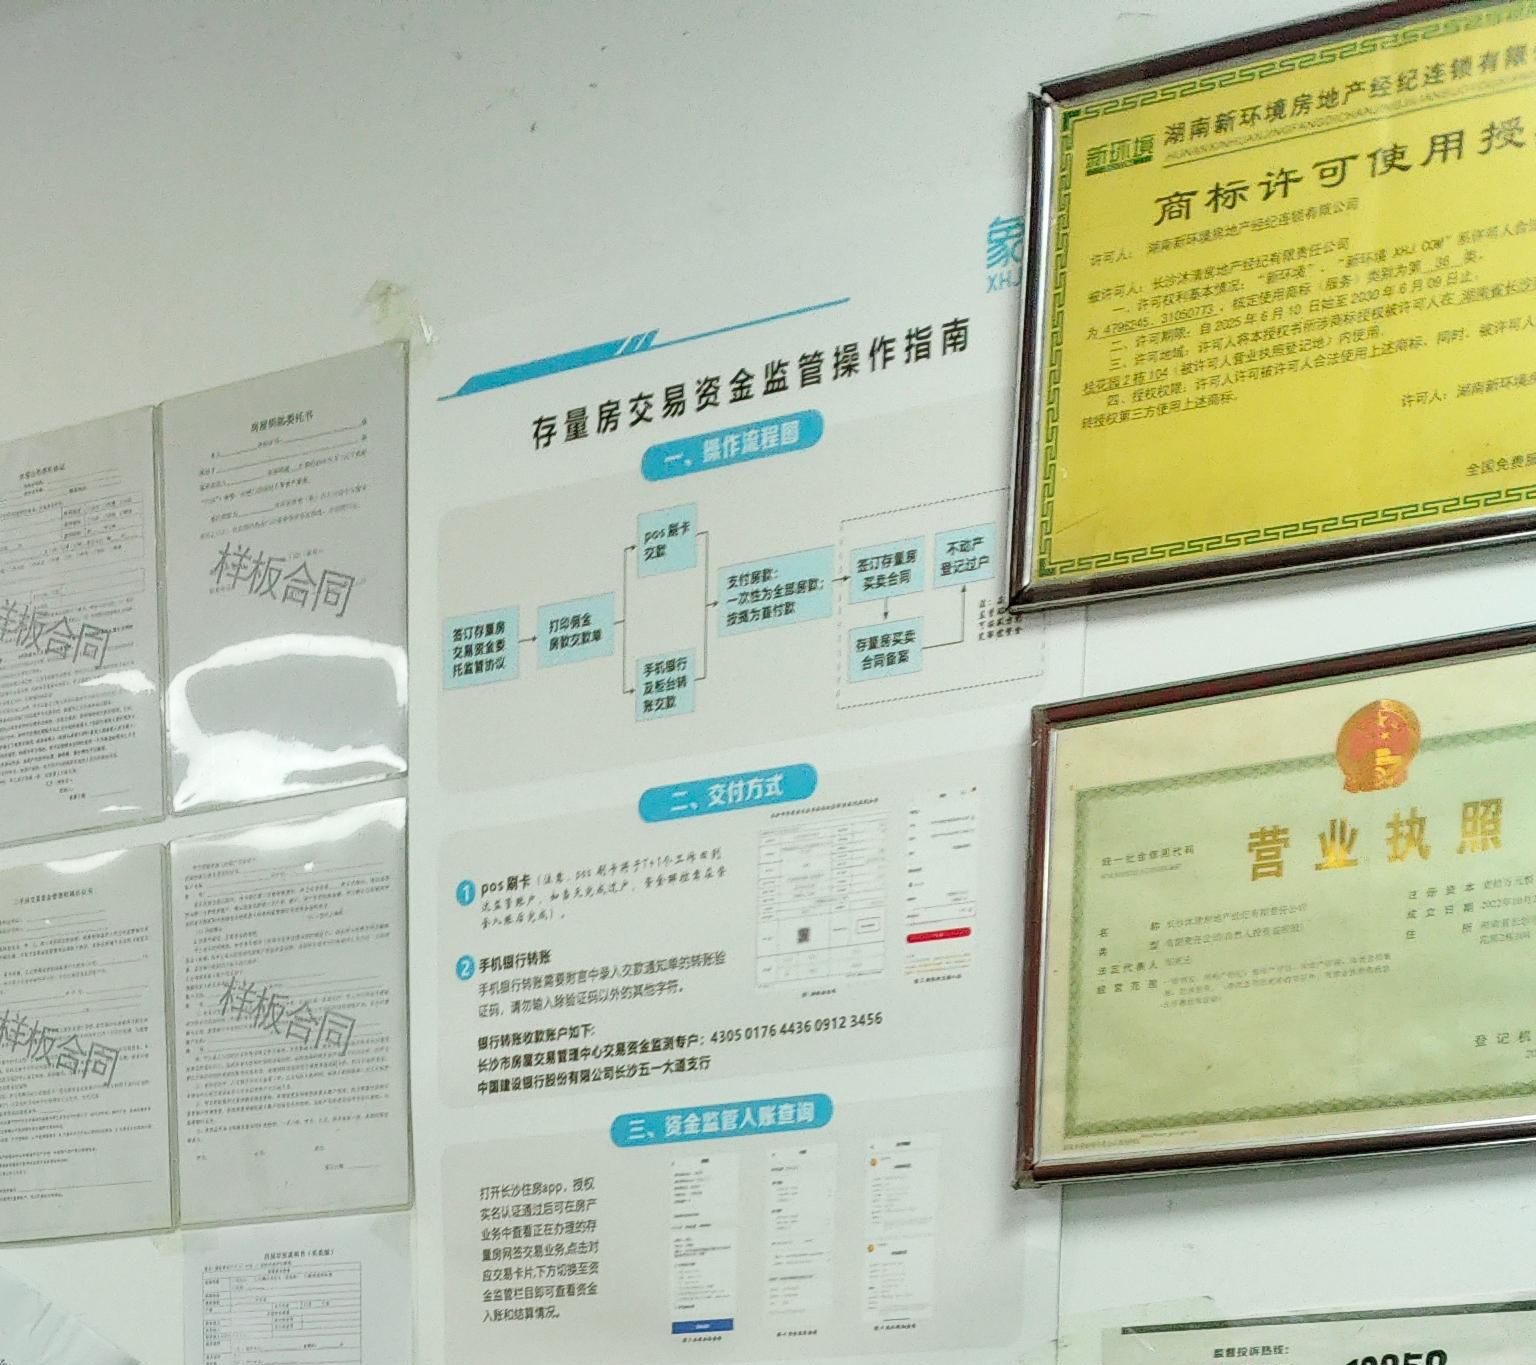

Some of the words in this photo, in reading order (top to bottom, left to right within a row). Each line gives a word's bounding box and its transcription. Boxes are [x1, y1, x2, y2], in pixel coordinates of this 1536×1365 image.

[1164, 44, 1536, 145] 湖南新环境房地产经纪连锁有限
[1086, 134, 1155, 167] 新环境
[1154, 115, 1526, 226] 商标许可使用授
[531, 316, 970, 450] 存量房交易资金监管操作指南
[663, 420, 801, 469] 一、操作流程图
[211, 541, 356, 617] 样板合同
[670, 773, 784, 812] 二、交付方式
[1247, 798, 1505, 881] 营业执照
[479, 949, 552, 974] 手机银行转账
[218, 976, 357, 1056] 样板合同
